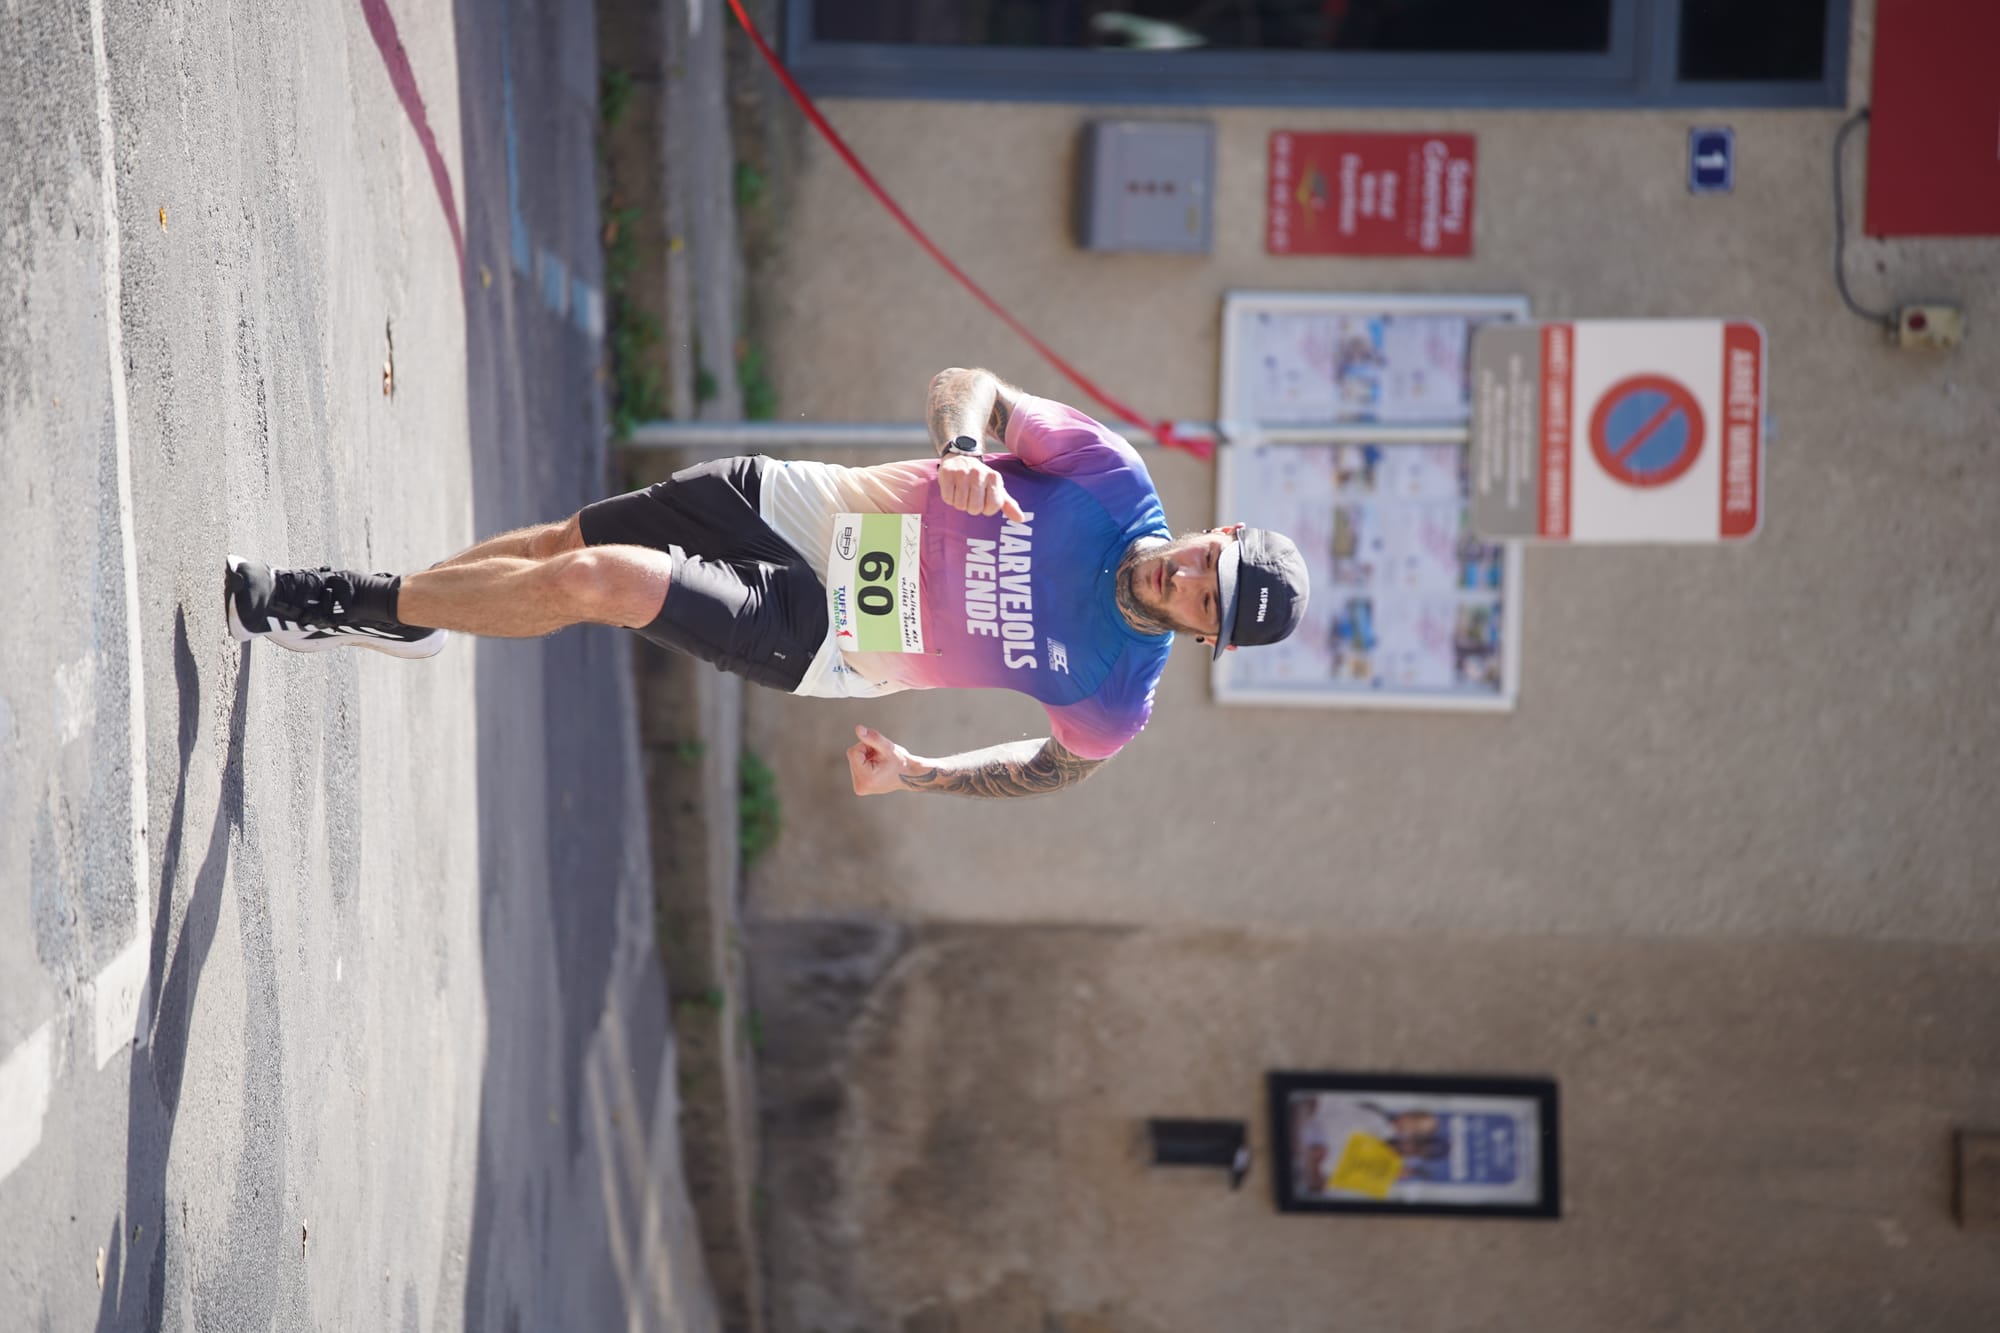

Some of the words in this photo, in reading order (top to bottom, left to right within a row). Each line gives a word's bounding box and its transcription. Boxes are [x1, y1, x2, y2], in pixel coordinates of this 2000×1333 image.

[1695, 150, 1727, 168] 1
[857, 551, 895, 616] 60
[908, 582, 917, 625] Challenge
[965, 538, 999, 638] MENDE
[998, 511, 1038, 669] MARVEJOLS
[1256, 587, 1269, 622] KIPRUN
[833, 589, 842, 630] Aventure
[838, 585, 847, 625] TUFF'S
